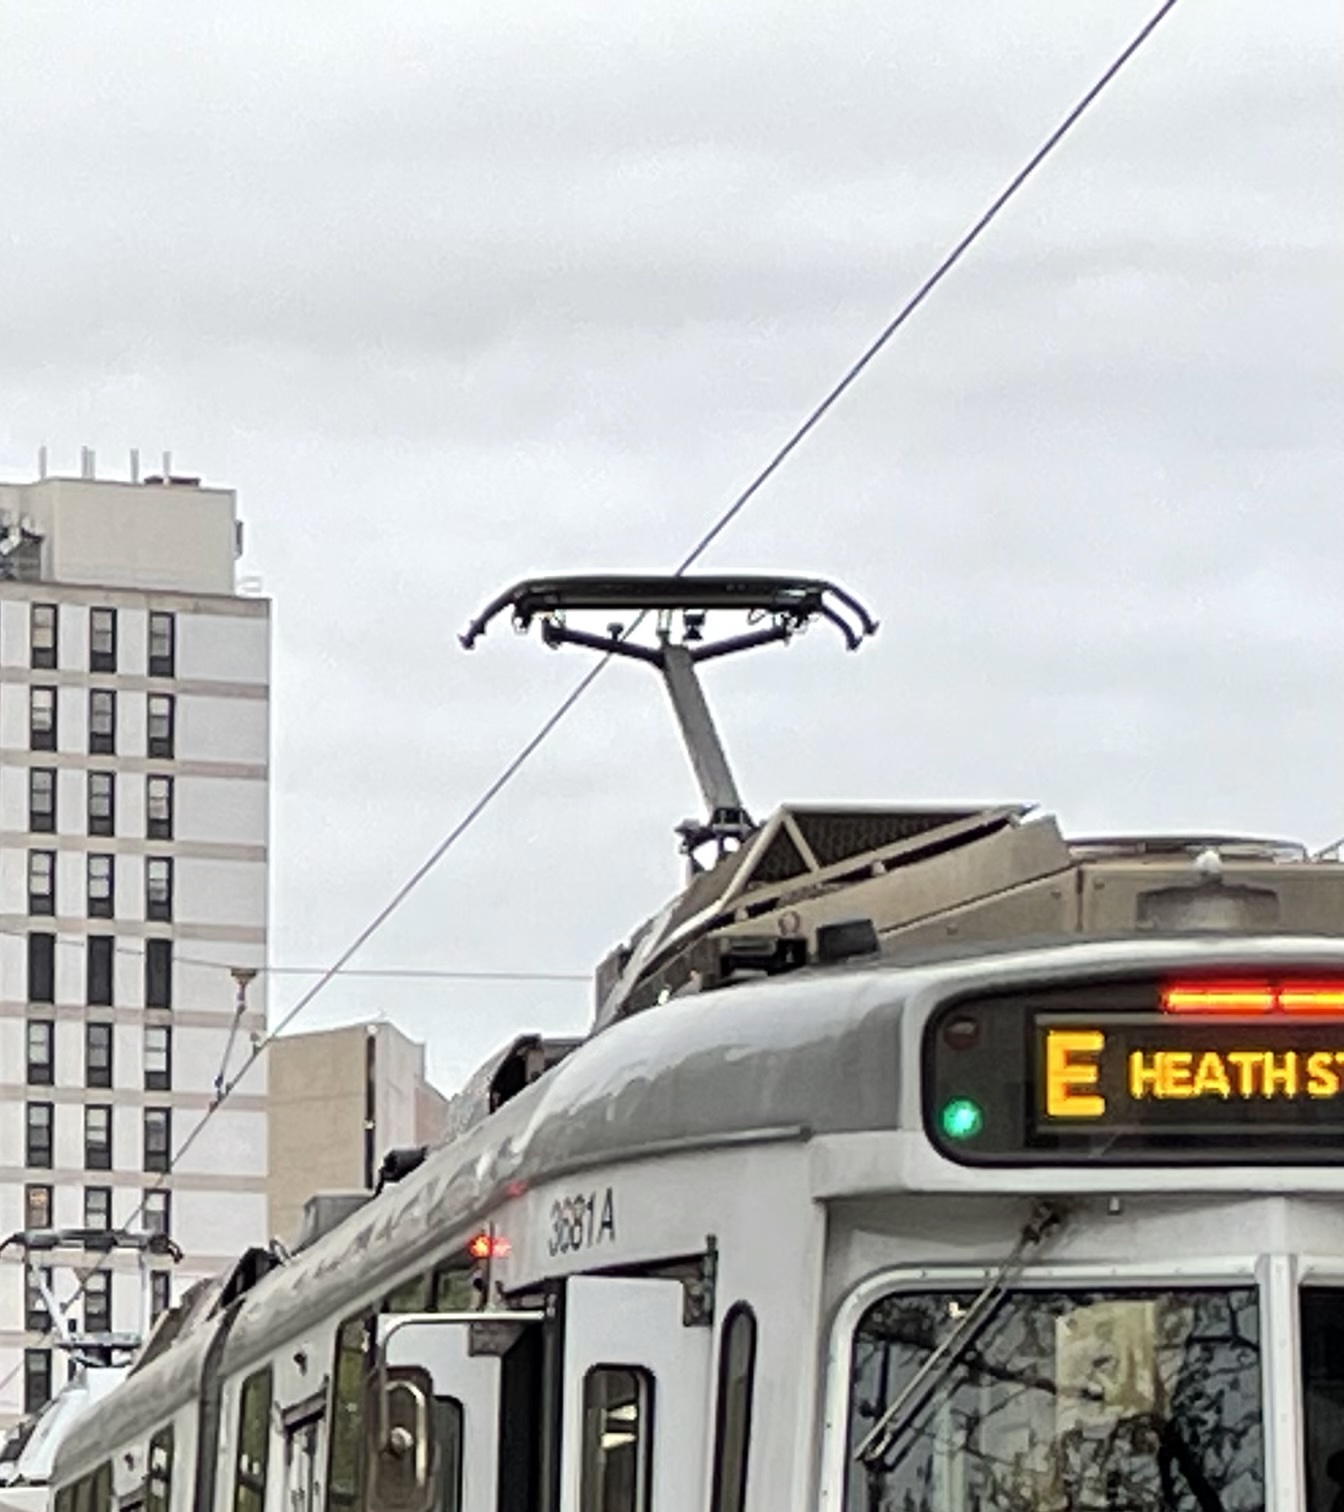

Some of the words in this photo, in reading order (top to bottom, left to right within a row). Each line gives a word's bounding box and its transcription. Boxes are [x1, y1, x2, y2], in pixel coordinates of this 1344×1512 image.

[1046, 1030, 1106, 1117] E
[1129, 1050, 1297, 1098] HEATH
[1306, 1050, 1344, 1098] S
